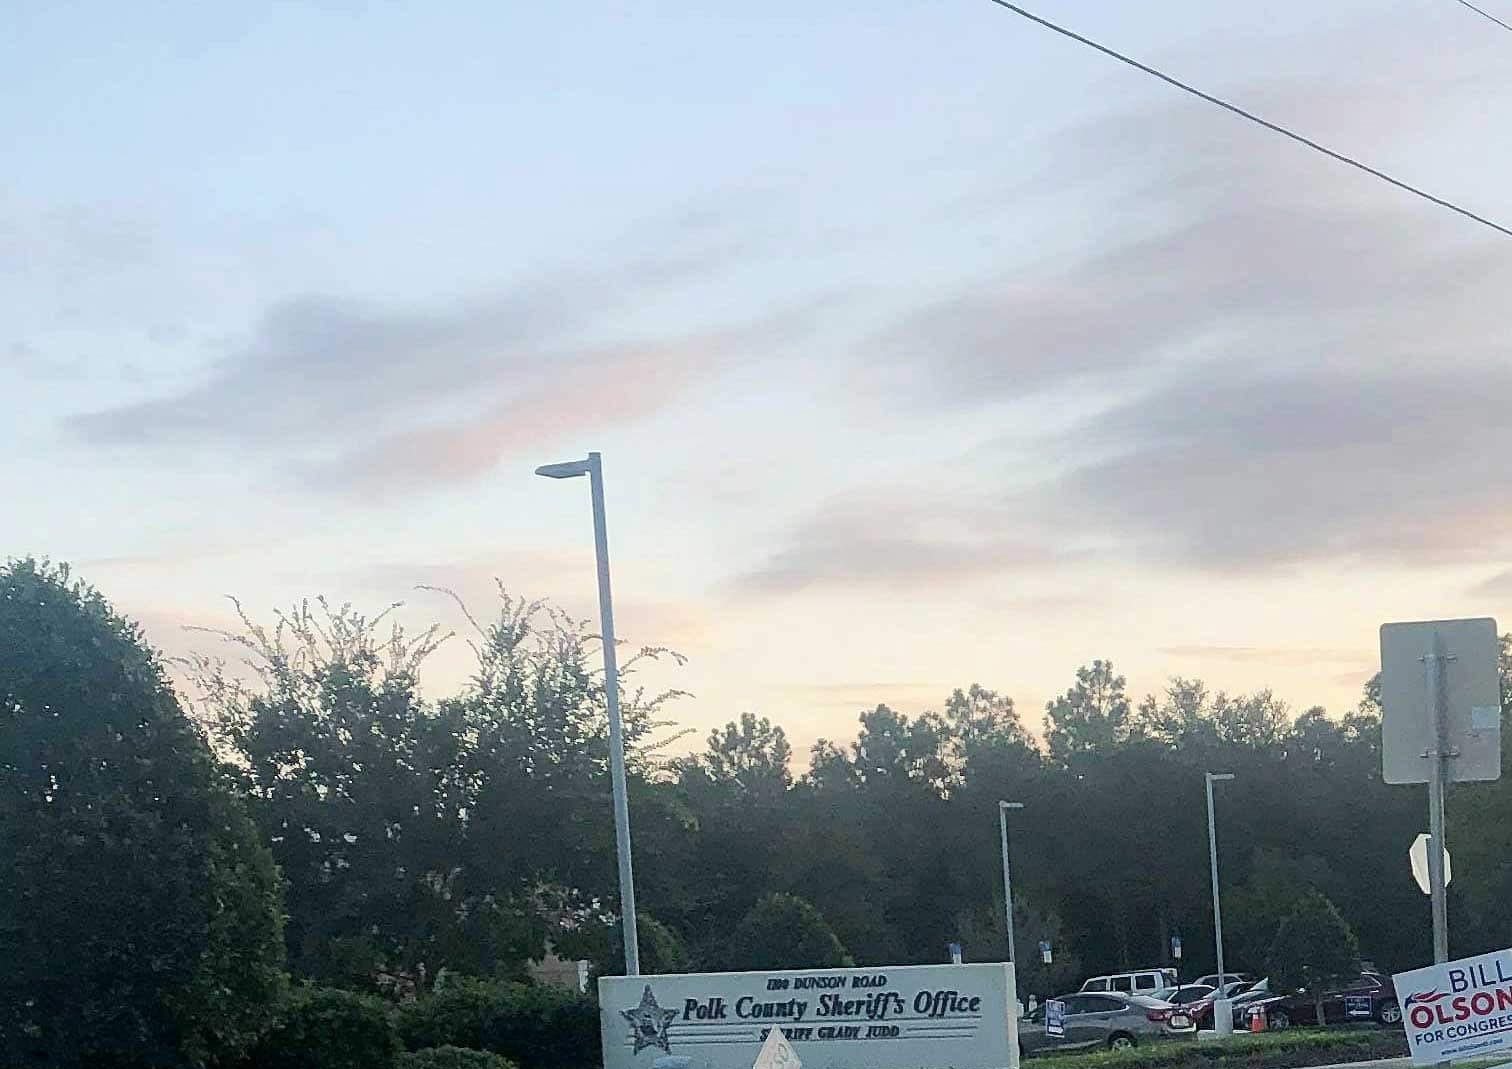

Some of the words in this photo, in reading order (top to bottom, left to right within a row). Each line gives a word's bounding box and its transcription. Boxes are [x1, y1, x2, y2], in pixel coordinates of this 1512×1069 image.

[793, 976, 847, 990] DUNSON
[851, 975, 887, 989] ROAD
[682, 997, 728, 1021] Polk
[735, 996, 808, 1021] County
[816, 991, 905, 1020] Sheriff's
[913, 990, 981, 1018] Office
[817, 1026, 860, 1040] GRADY
[865, 1025, 900, 1038] JUDD
[1415, 1030, 1444, 1046] FOR
